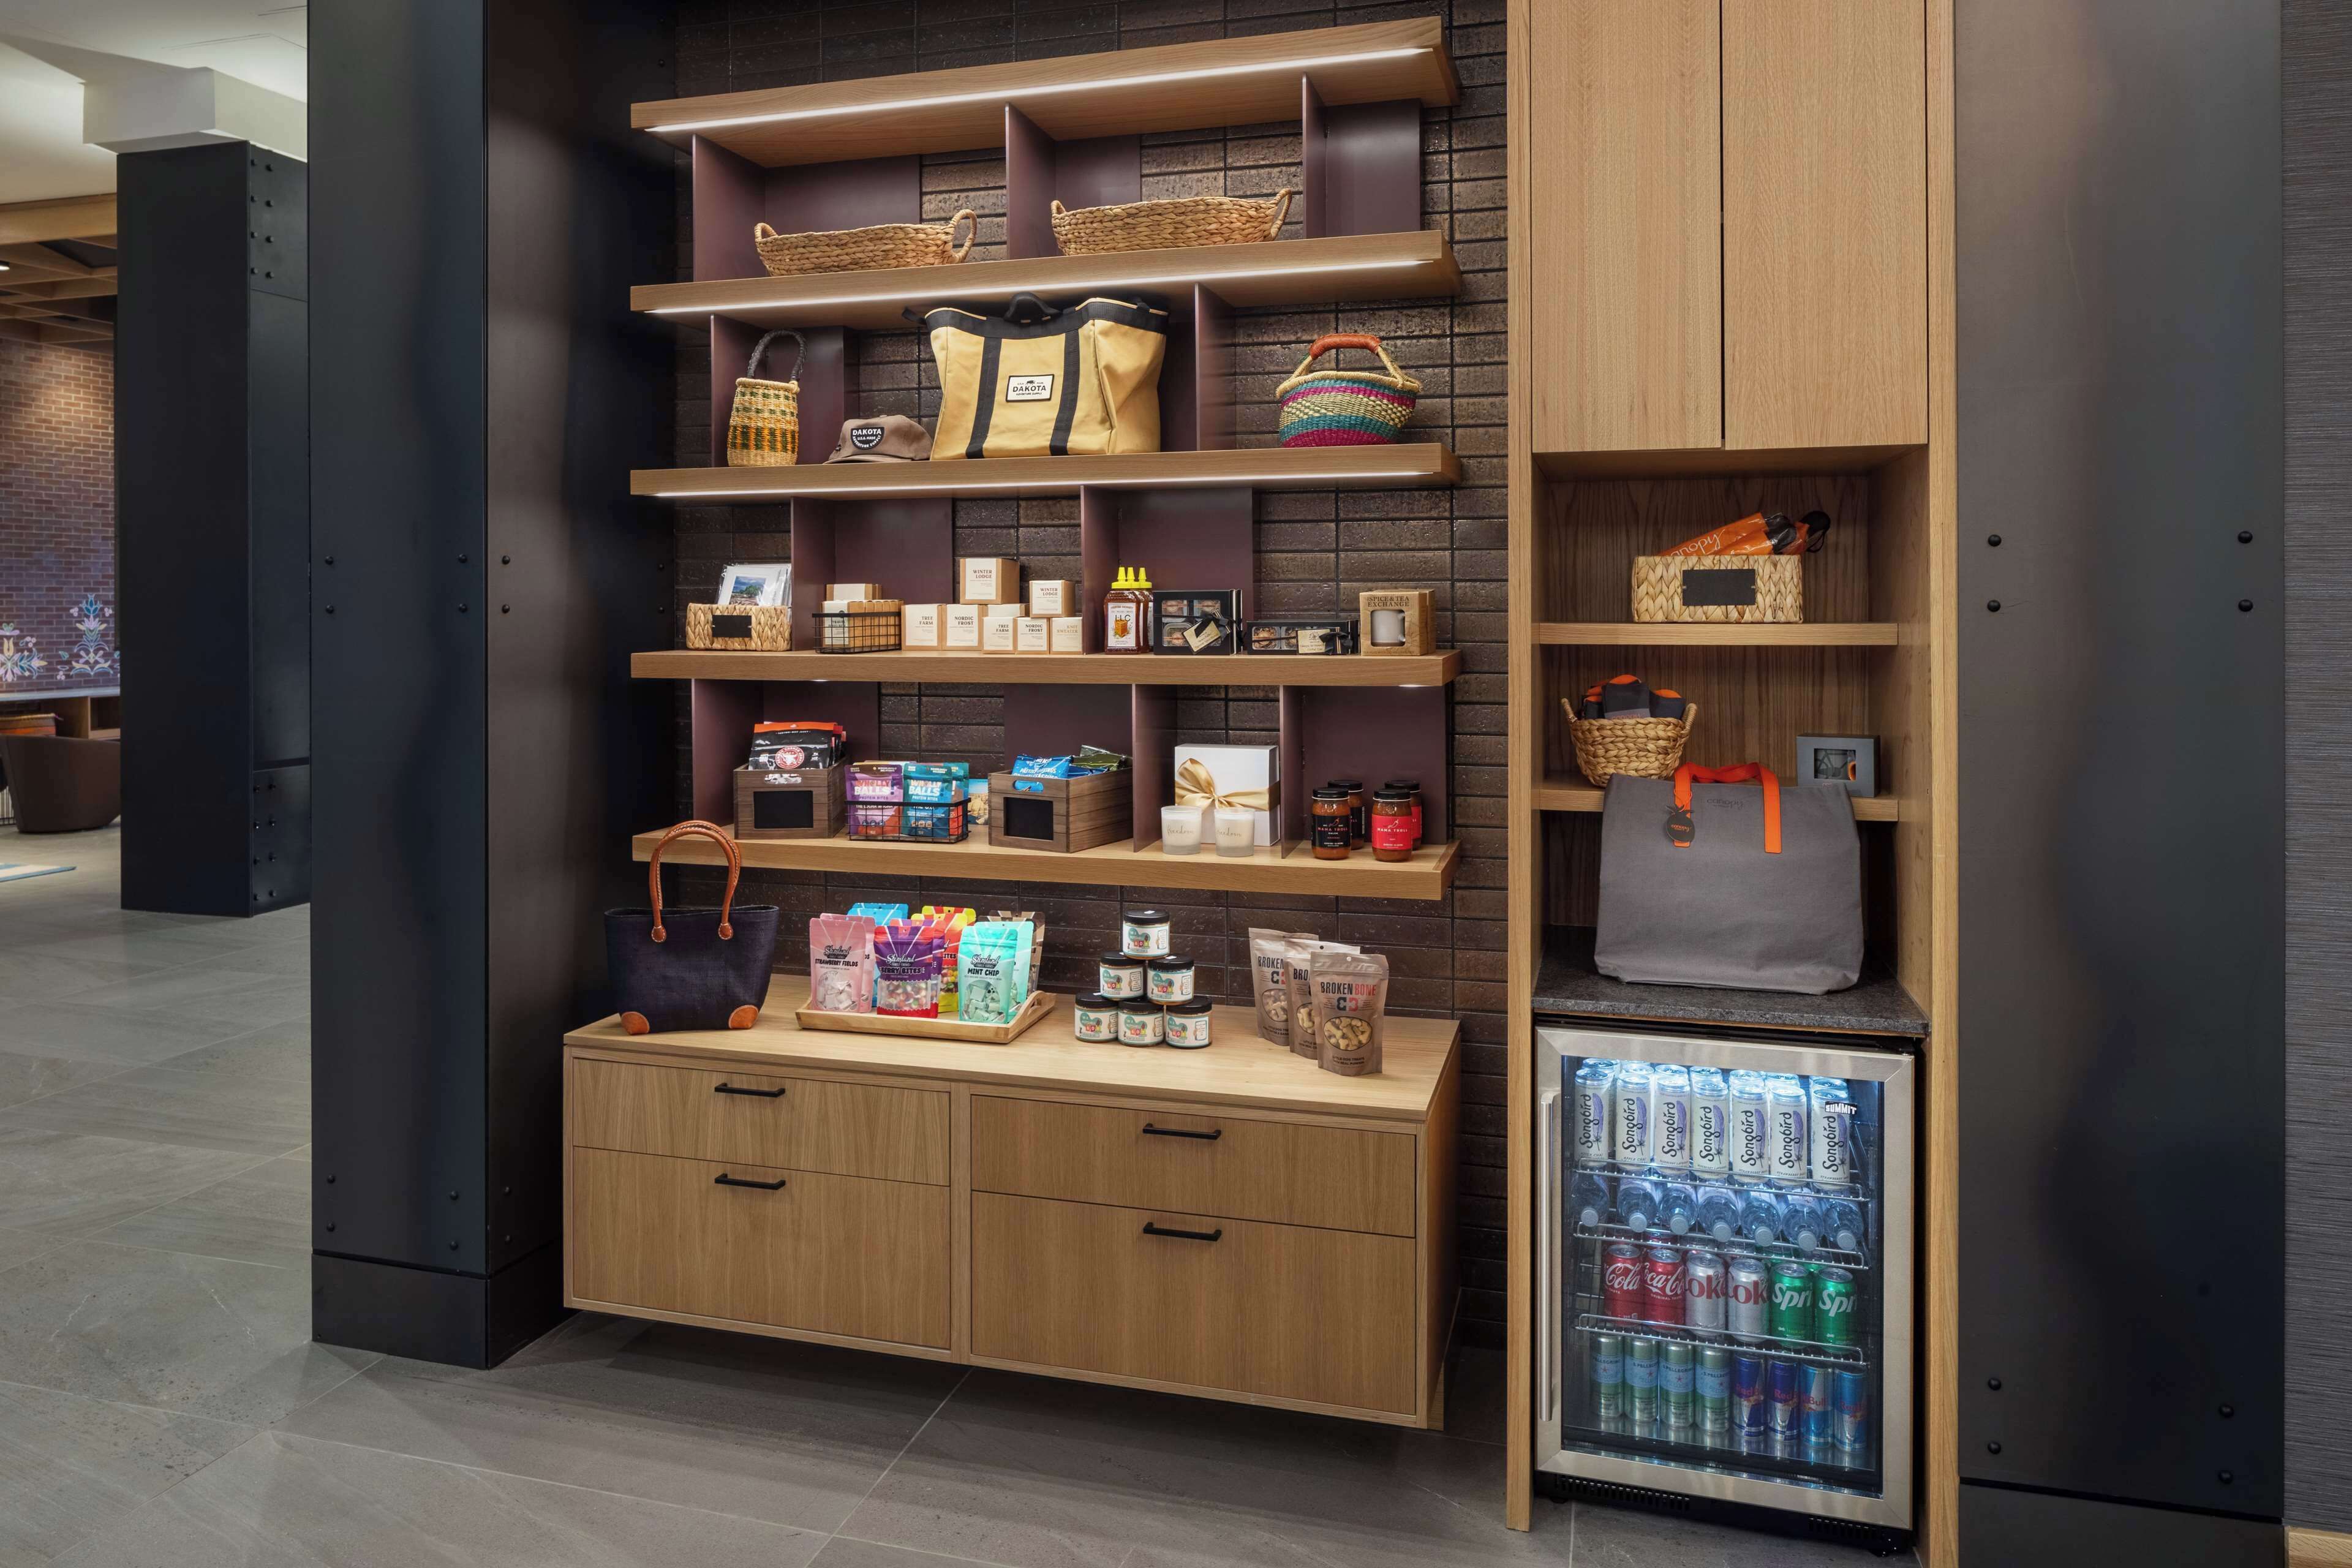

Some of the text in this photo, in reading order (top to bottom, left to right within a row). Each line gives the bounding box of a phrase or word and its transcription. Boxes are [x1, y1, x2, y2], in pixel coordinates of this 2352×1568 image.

[852, 434, 882, 448] ADVENTURE SUPPLY
[1706, 798, 1744, 810] canopy
[1670, 824, 1690, 832] canopy
[1258, 956, 1284, 970] BROKEN
[1293, 968, 1309, 981] BRO
[1321, 981, 1377, 996] BROKEN BONE
[1825, 1102, 1856, 1115] SUMMIT
[1579, 1094, 1599, 1149] Songbird
[1622, 1098, 1643, 1153] Songbird
[1662, 1102, 1683, 1158] Songbird
[1699, 1106, 1721, 1162] Songbird
[1741, 1110, 1762, 1166] Songbird
[1779, 1112, 1800, 1169] Songbird
[1823, 1115, 1844, 1172] Songbird
[1772, 1283, 1814, 1311] Spri
[1774, 1389, 1792, 1400] Red
[1809, 1396, 1826, 1407] Bull
